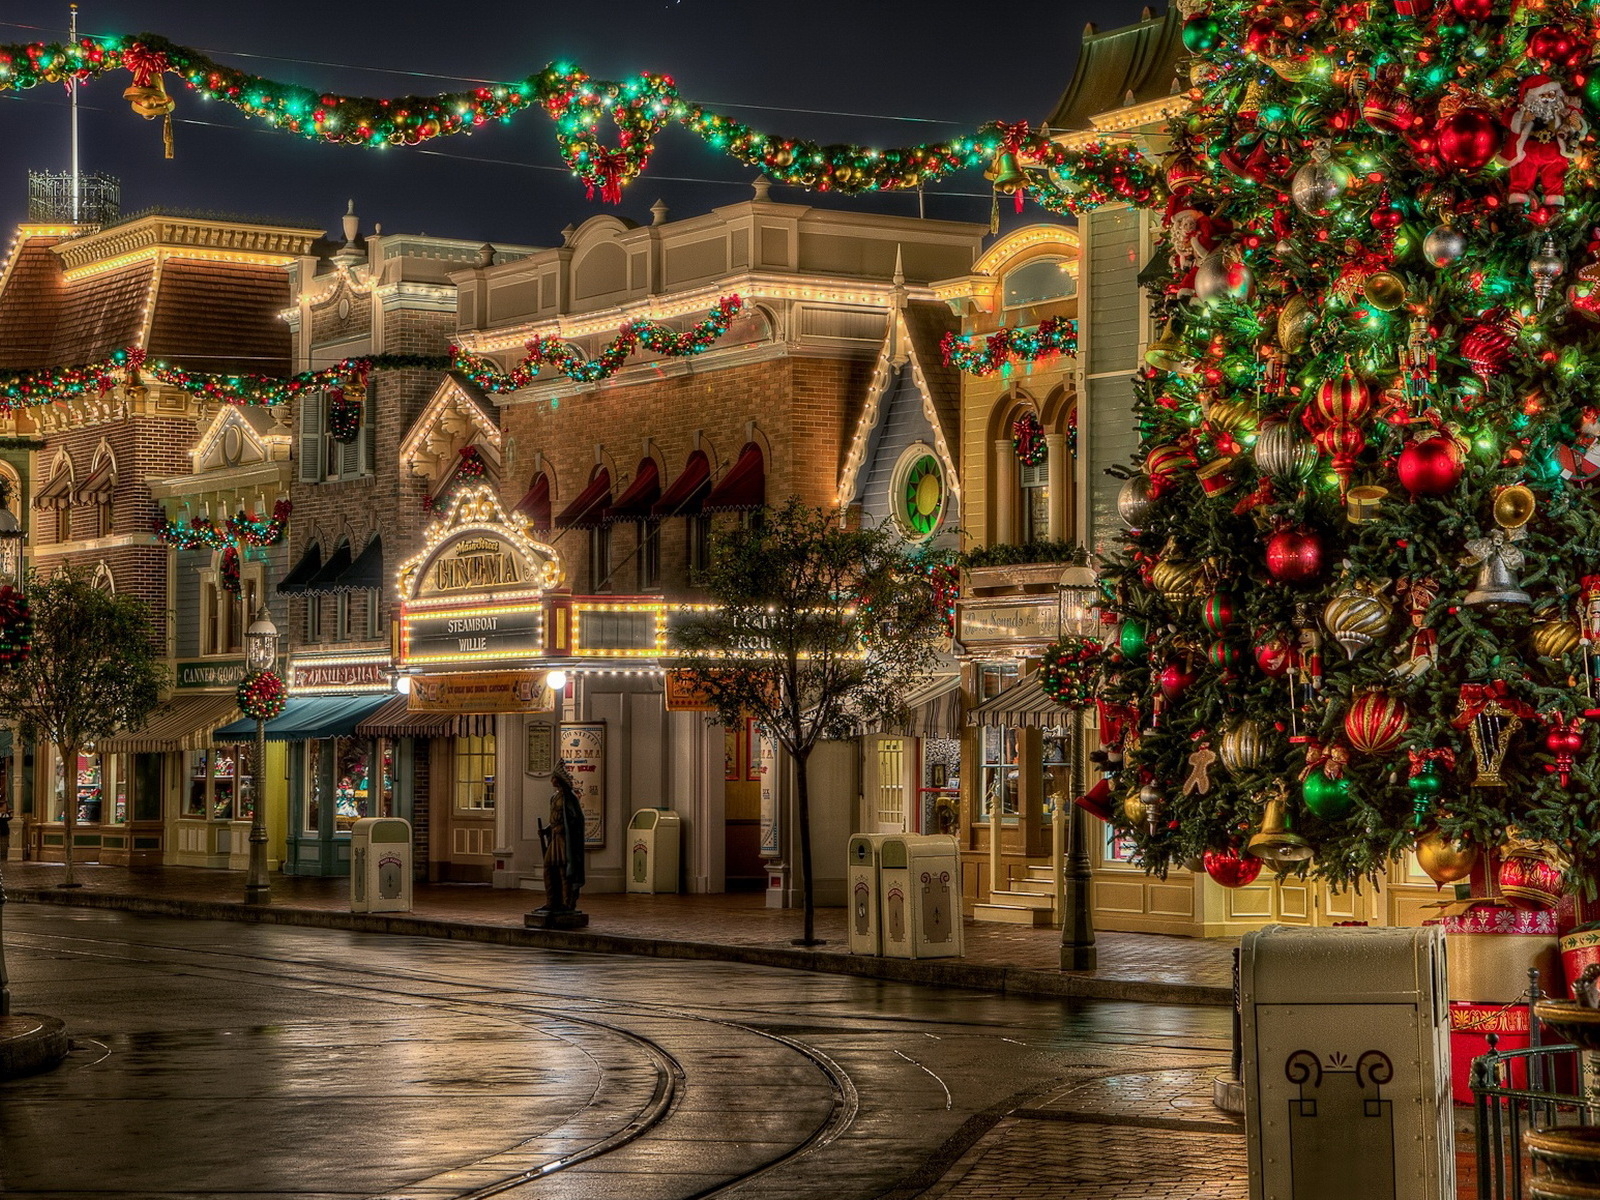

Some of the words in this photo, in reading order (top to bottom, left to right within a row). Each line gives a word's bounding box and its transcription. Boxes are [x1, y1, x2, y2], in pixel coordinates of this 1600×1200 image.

[455, 540, 476, 556] Main
[476, 537, 500, 552] Street
[436, 551, 520, 592] CINEMA
[447, 617, 498, 633] STEAMBOAT
[458, 637, 487, 652] WILLIE
[183, 667, 215, 683] CANNED
[561, 749, 601, 758] INEMA
